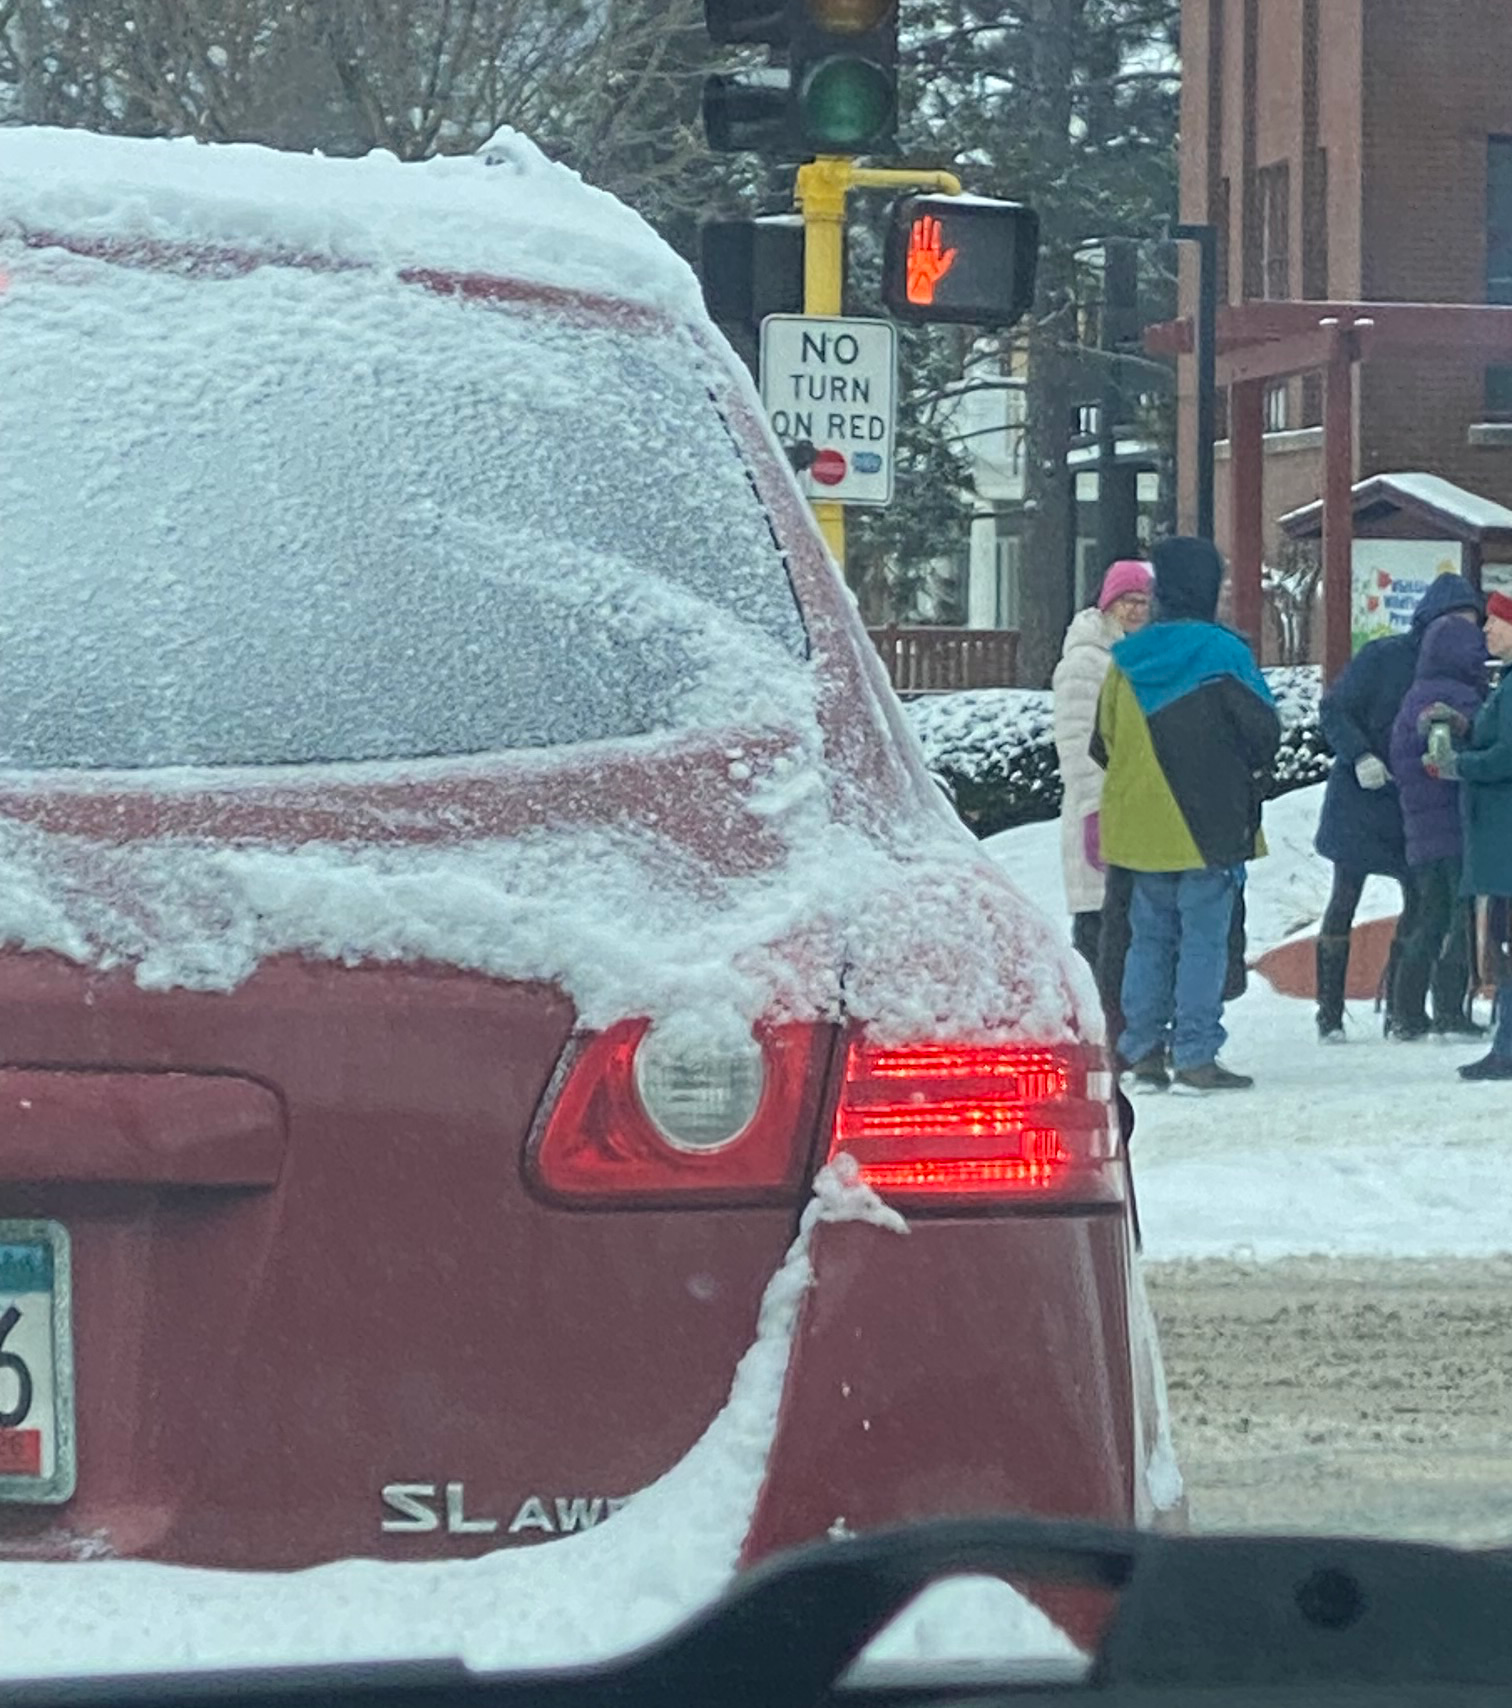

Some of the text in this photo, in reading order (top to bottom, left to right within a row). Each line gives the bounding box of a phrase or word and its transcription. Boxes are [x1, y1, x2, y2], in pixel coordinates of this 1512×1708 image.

[801, 331, 859, 365] NO
[789, 374, 869, 404] TURN
[771, 410, 885, 441] ON RED
[381, 1482, 498, 1533] SL
